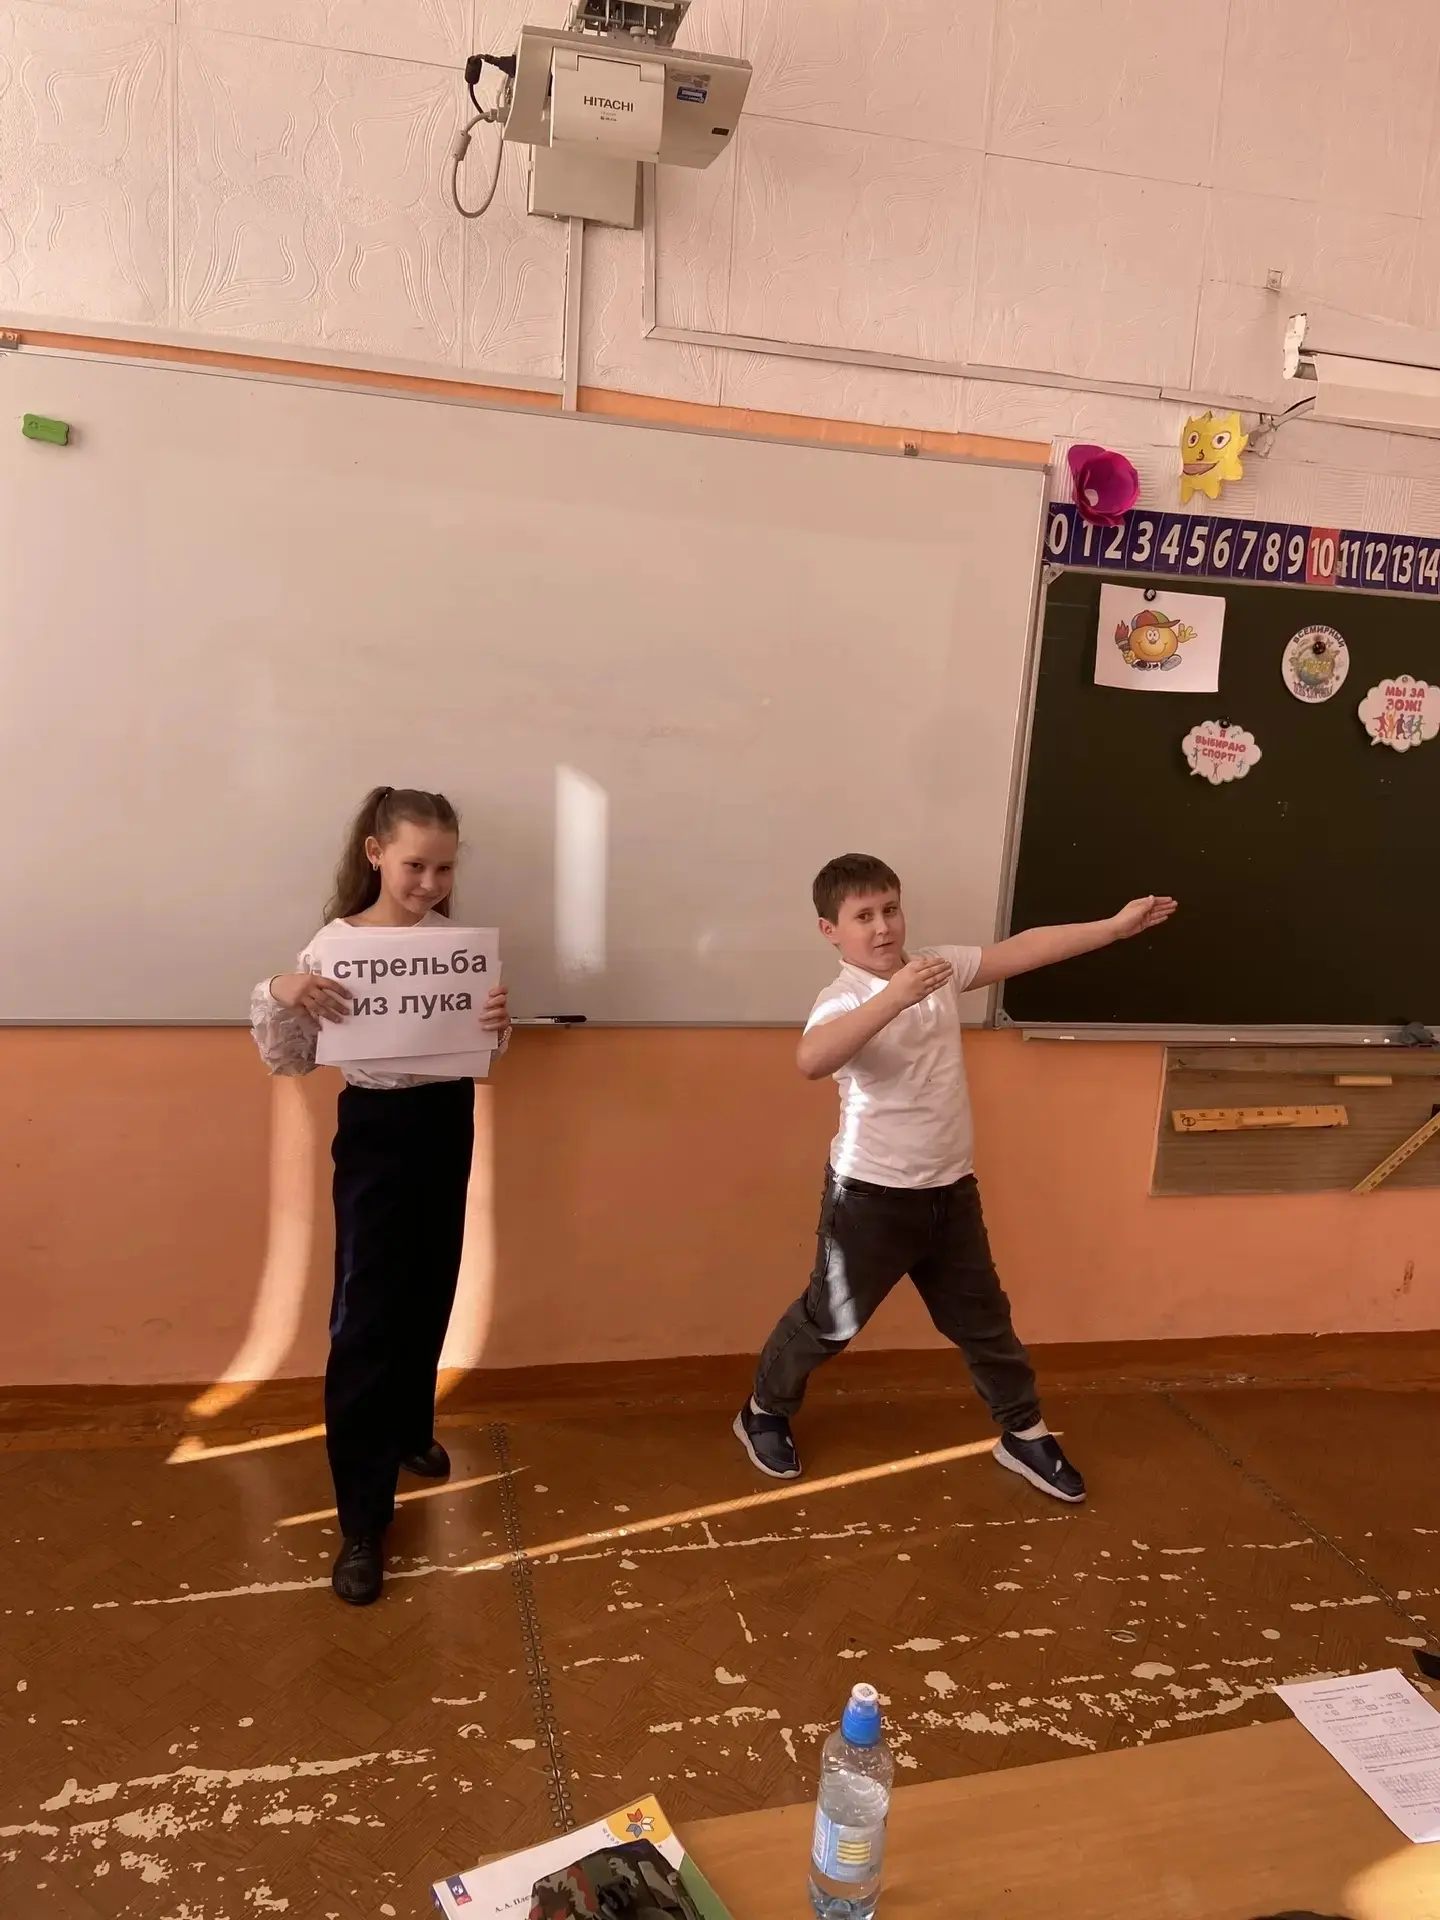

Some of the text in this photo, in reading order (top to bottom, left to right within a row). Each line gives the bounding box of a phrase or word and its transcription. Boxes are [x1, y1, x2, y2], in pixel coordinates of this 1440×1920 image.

[583, 95, 634, 112] HITACHI
[1050, 513, 1440, 587] 0 1 2 3 4 5 6 7 8 9 10 11 12 13 14
[1385, 686, 1425, 698] МЫ ЗА
[1386, 698, 1422, 712] ЗОЖ!
[1219, 729, 1227, 738] Я
[1195, 735, 1246, 752] ВЫБИРАЮ
[1202, 748, 1236, 762] СПОРТ!
[333, 949, 487, 984] стрельба
[353, 991, 472, 1019] из лука
